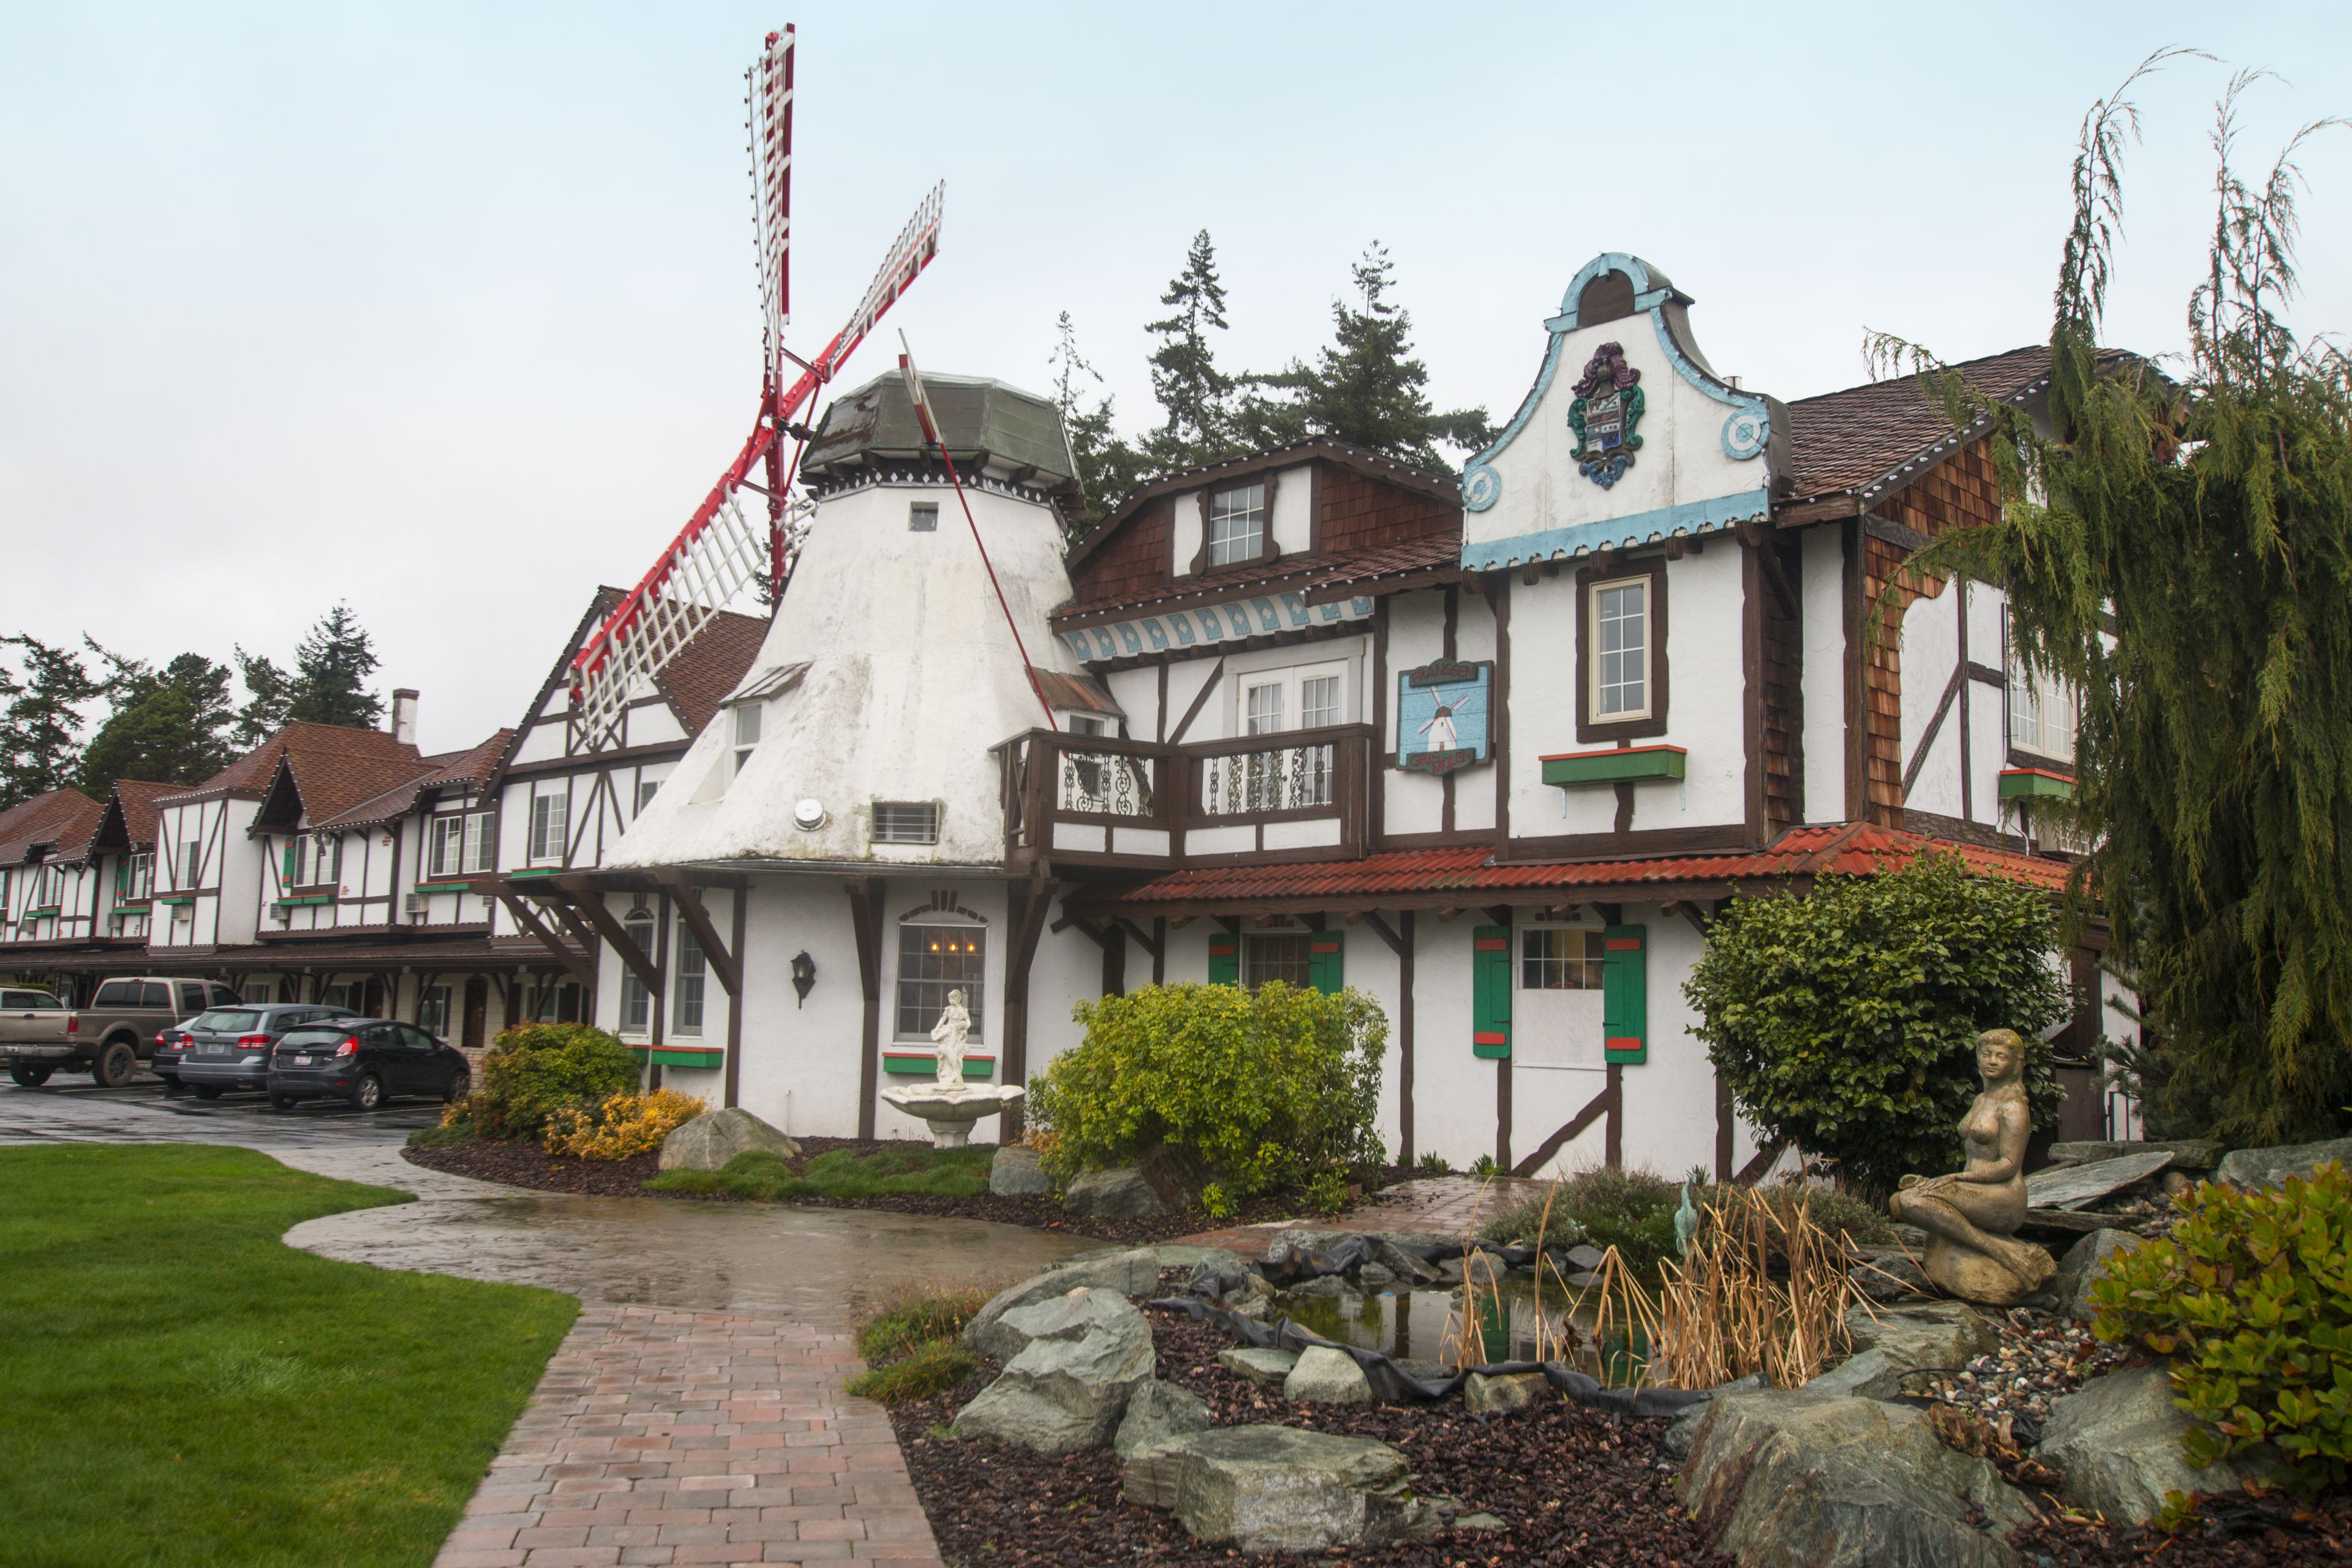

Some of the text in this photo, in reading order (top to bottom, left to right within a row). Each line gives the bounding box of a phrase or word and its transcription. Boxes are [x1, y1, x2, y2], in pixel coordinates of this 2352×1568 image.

[1411, 663, 1476, 685] FRANSSEN
[1411, 752, 1441, 767] GRIS
[1432, 749, 1473, 774] MOLEN
